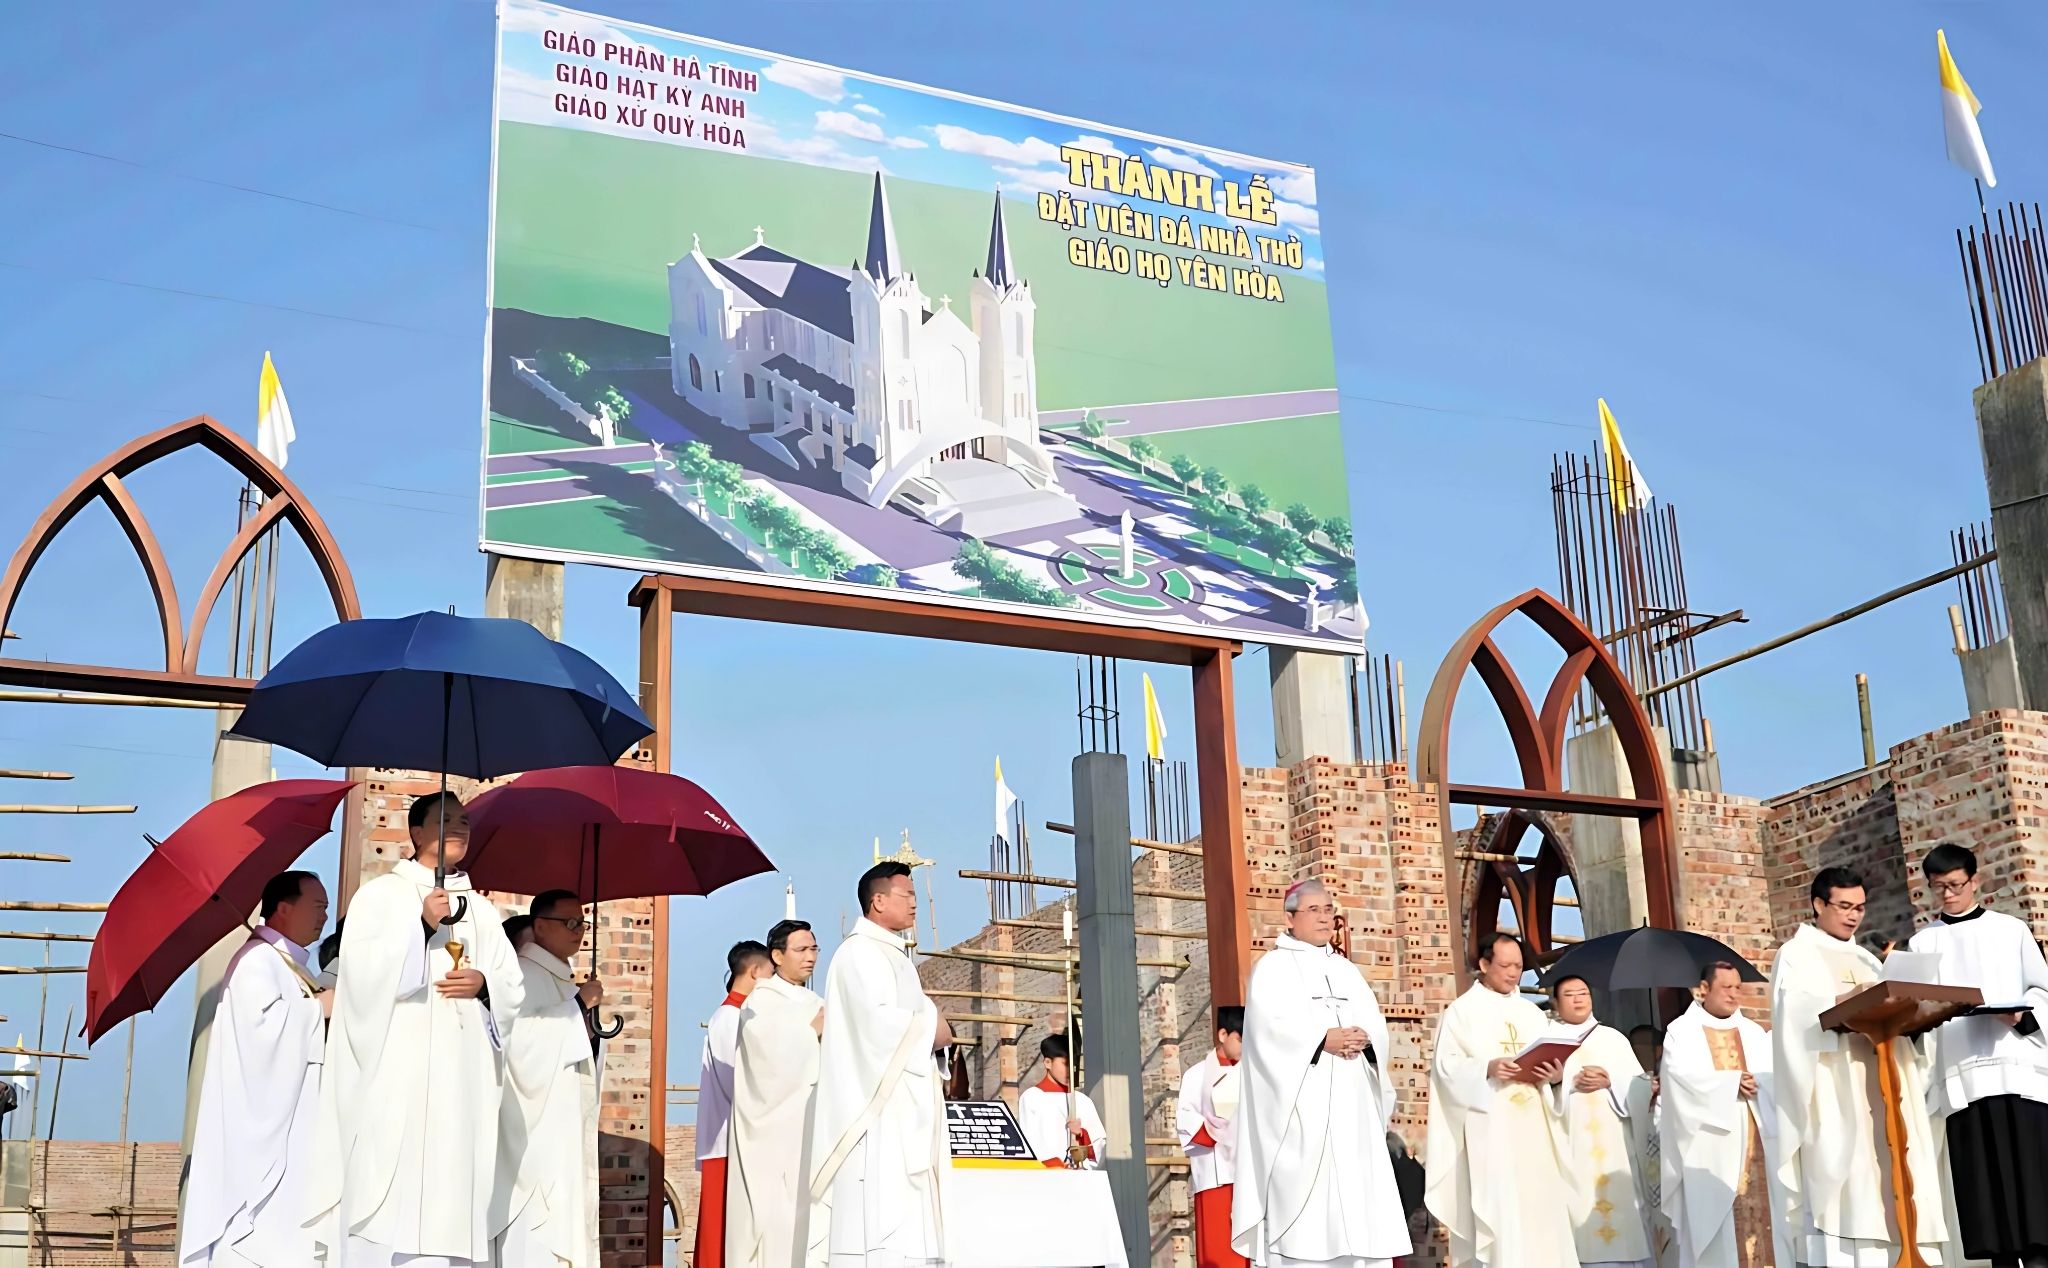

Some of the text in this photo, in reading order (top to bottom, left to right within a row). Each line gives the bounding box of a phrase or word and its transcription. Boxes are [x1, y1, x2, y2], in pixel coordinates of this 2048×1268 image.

[544, 30, 757, 92] GIÁO PHẬN HÀ TĨNH
[556, 63, 608, 90] GIÁO
[617, 75, 658, 102] HẠT
[701, 93, 745, 118] ANH
[555, 93, 607, 120] GIÁO
[616, 104, 648, 128] XỨ
[703, 122, 746, 148] HÒA
[1060, 146, 1277, 226] THÁNH LỄ
[1037, 190, 1303, 269] ĐẶT VIÊN ĐÁ NHÀ THỜ
[1068, 237, 1284, 302] GIÁO HỌ YÊN HÒA
